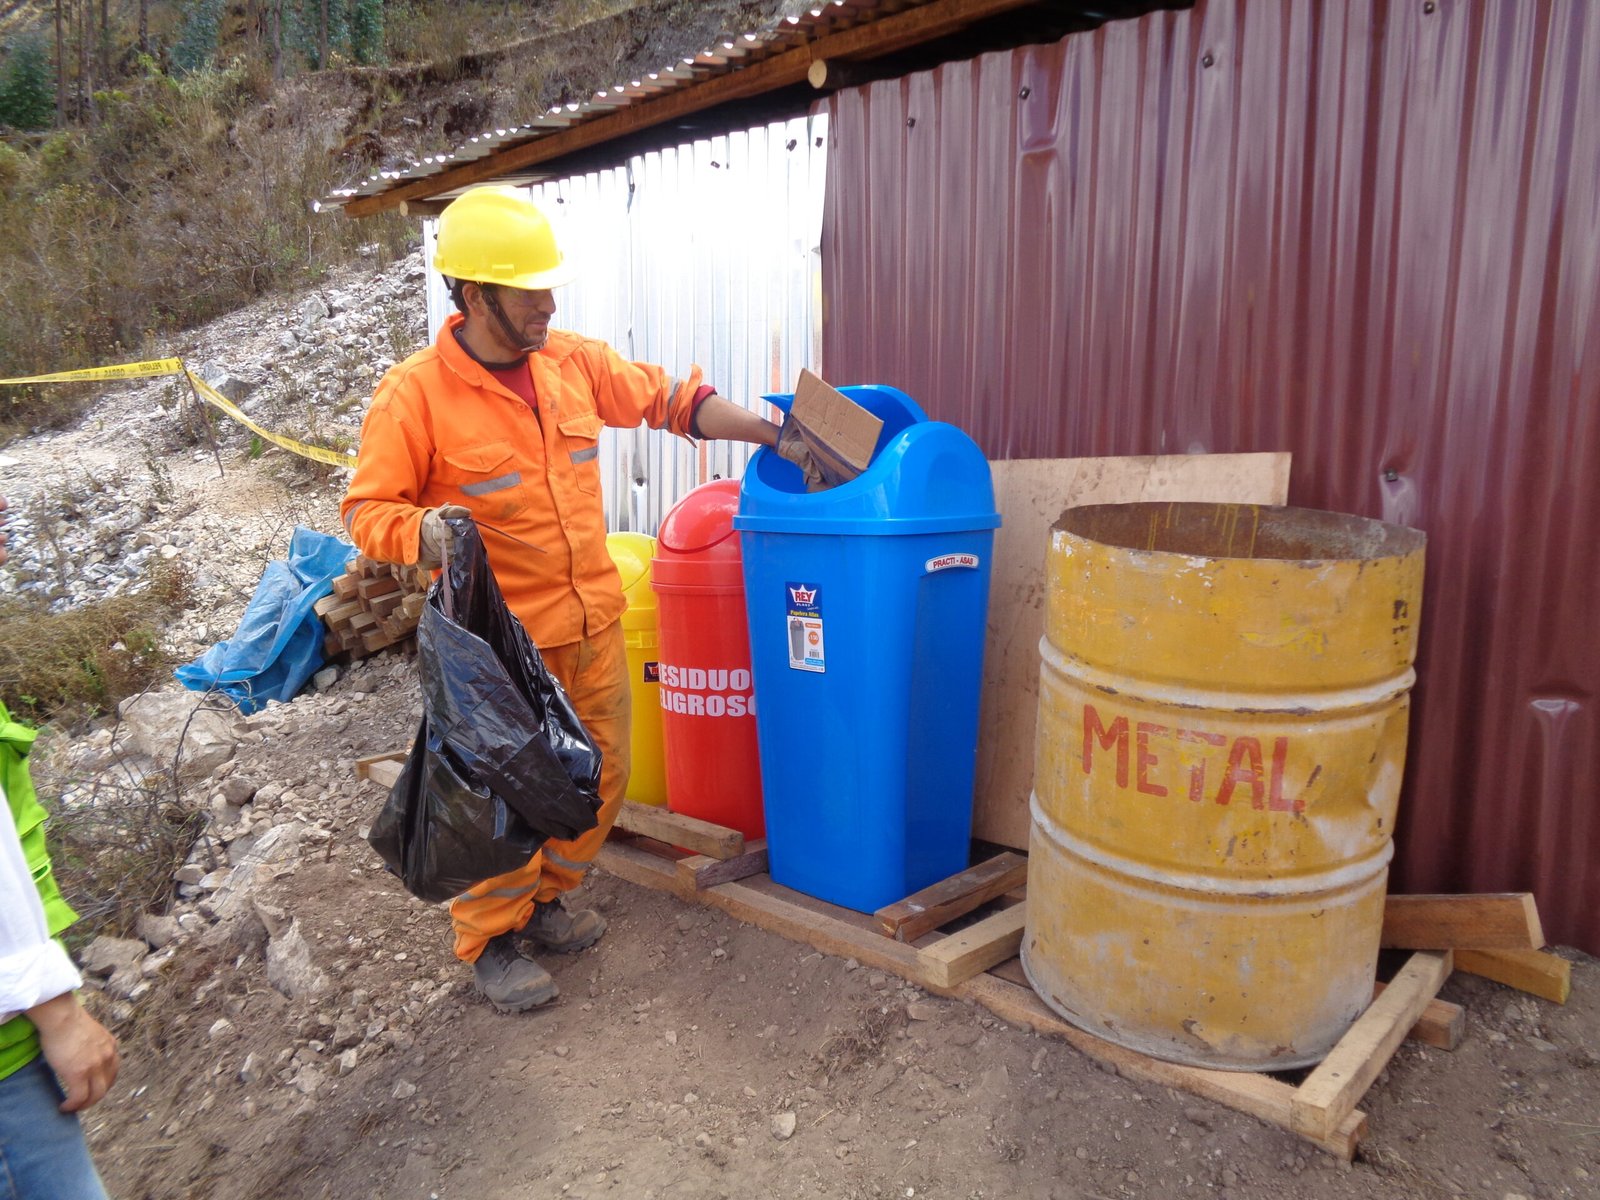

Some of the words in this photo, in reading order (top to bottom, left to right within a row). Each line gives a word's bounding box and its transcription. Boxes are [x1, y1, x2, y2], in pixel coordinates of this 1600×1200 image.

[795, 592, 813, 602] REY
[658, 662, 753, 690] ESIDUO
[1082, 703, 1306, 814] METAL
